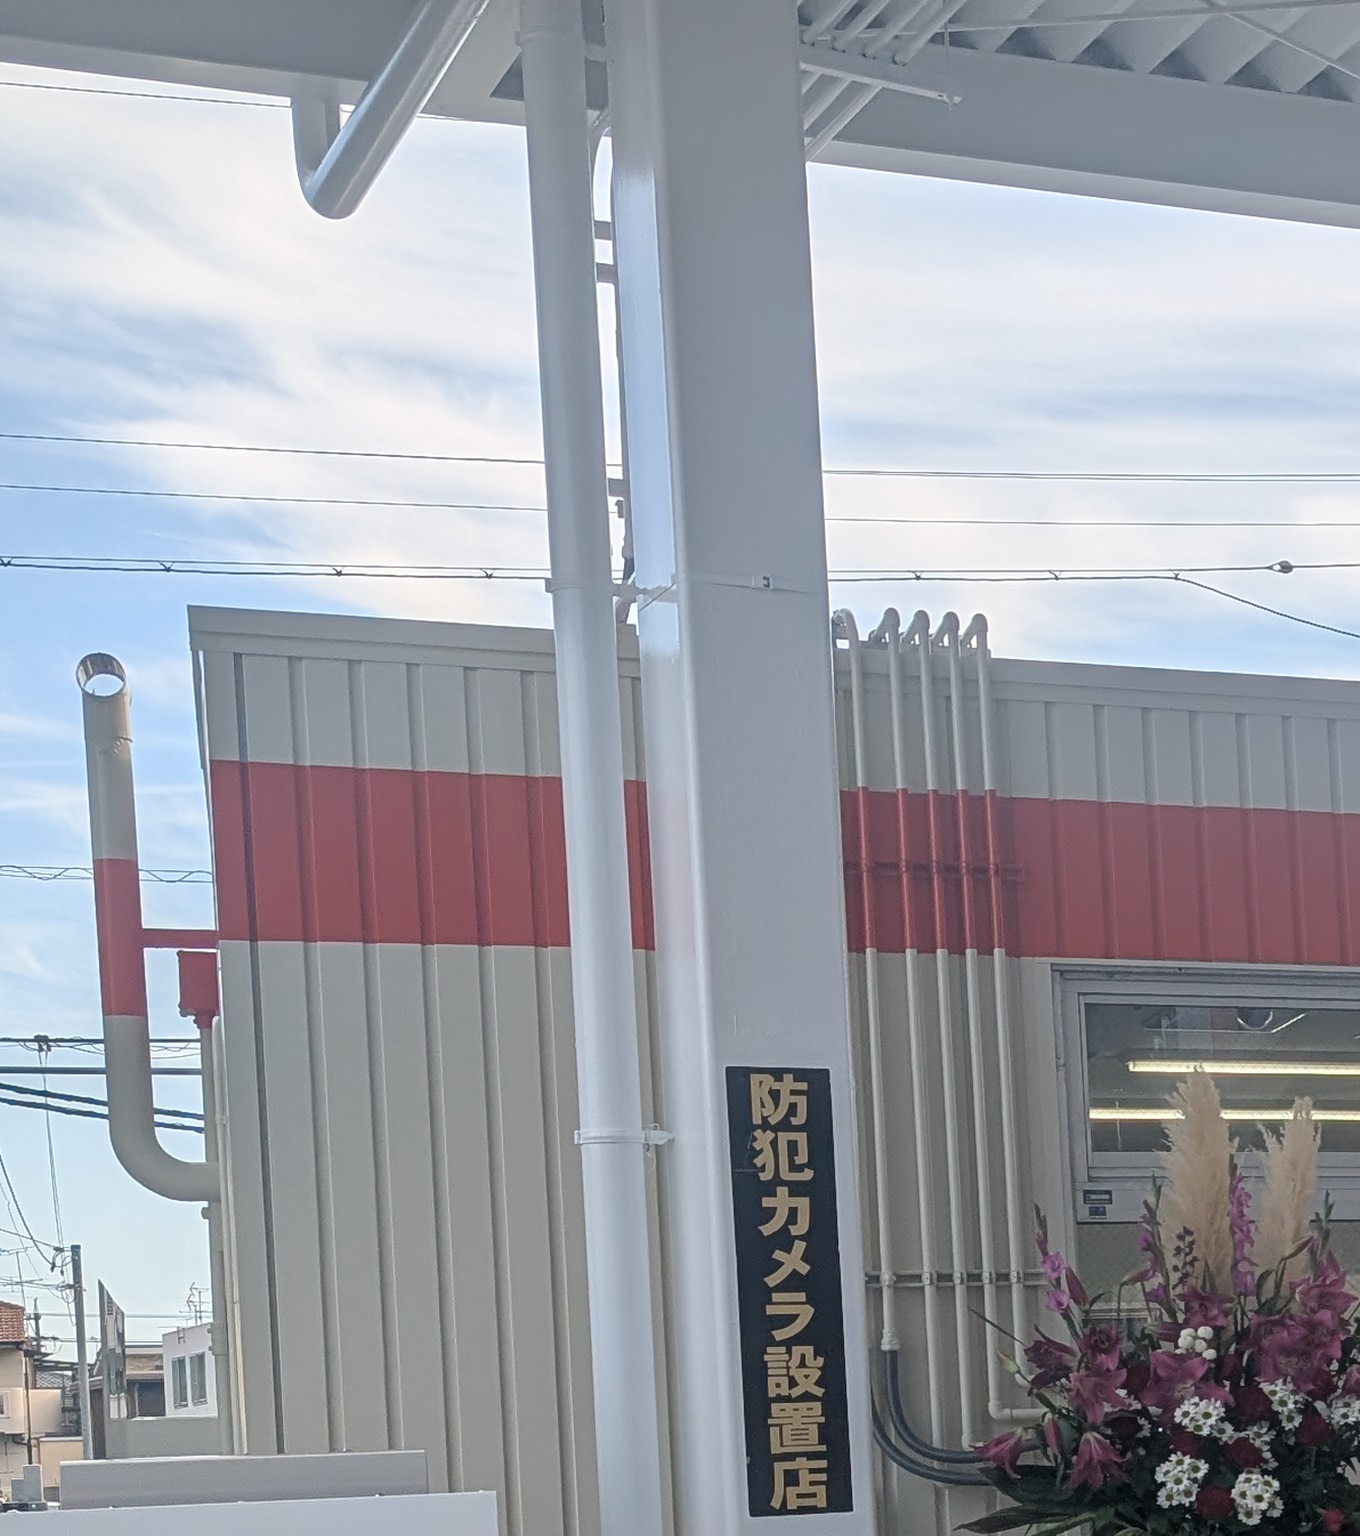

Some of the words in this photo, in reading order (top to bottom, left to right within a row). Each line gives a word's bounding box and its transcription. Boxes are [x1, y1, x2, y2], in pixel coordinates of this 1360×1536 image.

[749, 1073, 828, 1511] 防犯カメラ設置店
